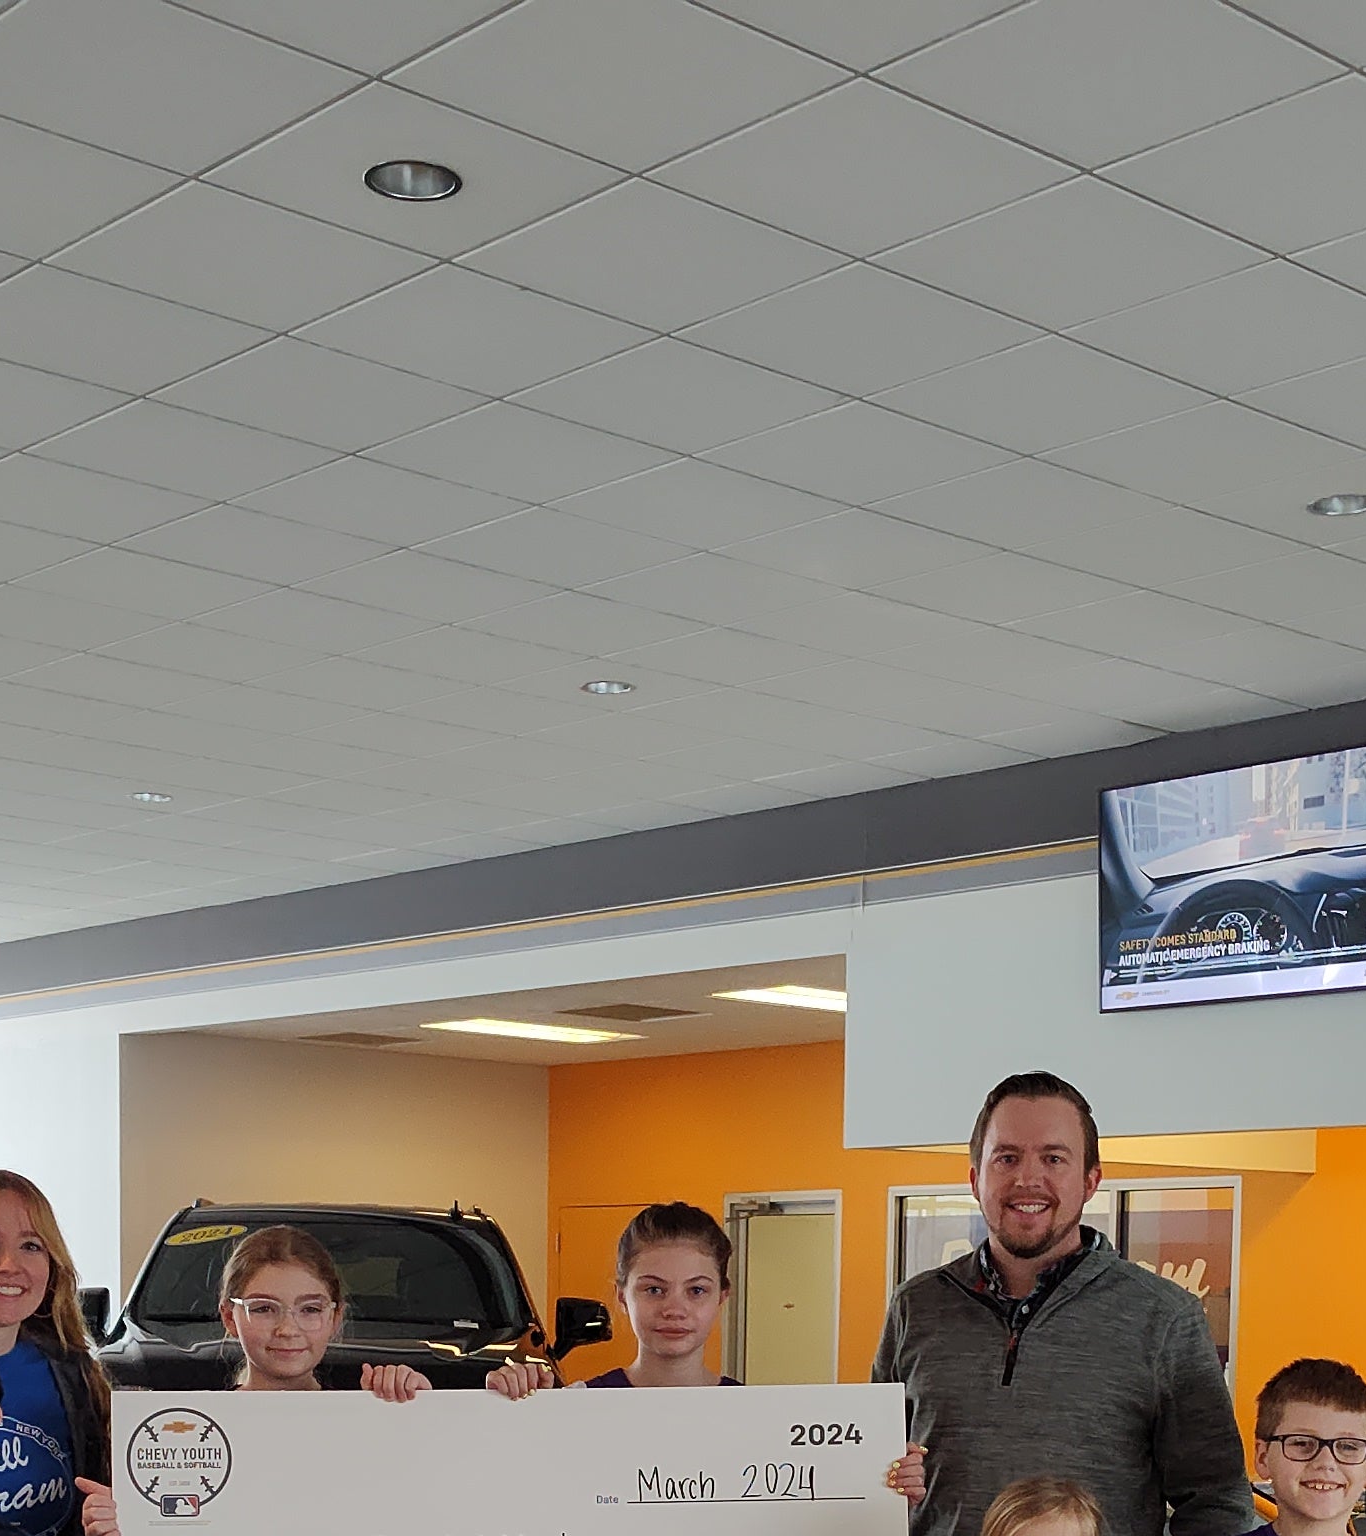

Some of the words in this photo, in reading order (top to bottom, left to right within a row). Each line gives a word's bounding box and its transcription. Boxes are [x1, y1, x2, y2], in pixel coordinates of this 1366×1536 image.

[1119, 938, 1151, 952] SAFETY
[1155, 935, 1185, 948] COMES
[1187, 928, 1237, 944] STANDARD
[1119, 949, 1170, 966] AUTOMATIC
[1171, 944, 1228, 961] EMERGENCY
[1228, 939, 1270, 955] BRAKING
[179, 1227, 233, 1243] 2024
[16, 1423, 40, 1438] NEW
[41, 1436, 68, 1460] YORK
[790, 1423, 863, 1446] 2024
[137, 1447, 177, 1460] CHEVY
[182, 1447, 222, 1460] YOUTH
[638, 1466, 715, 1502] March
[741, 1463, 817, 1500] 2024
[596, 1495, 619, 1505] Date
